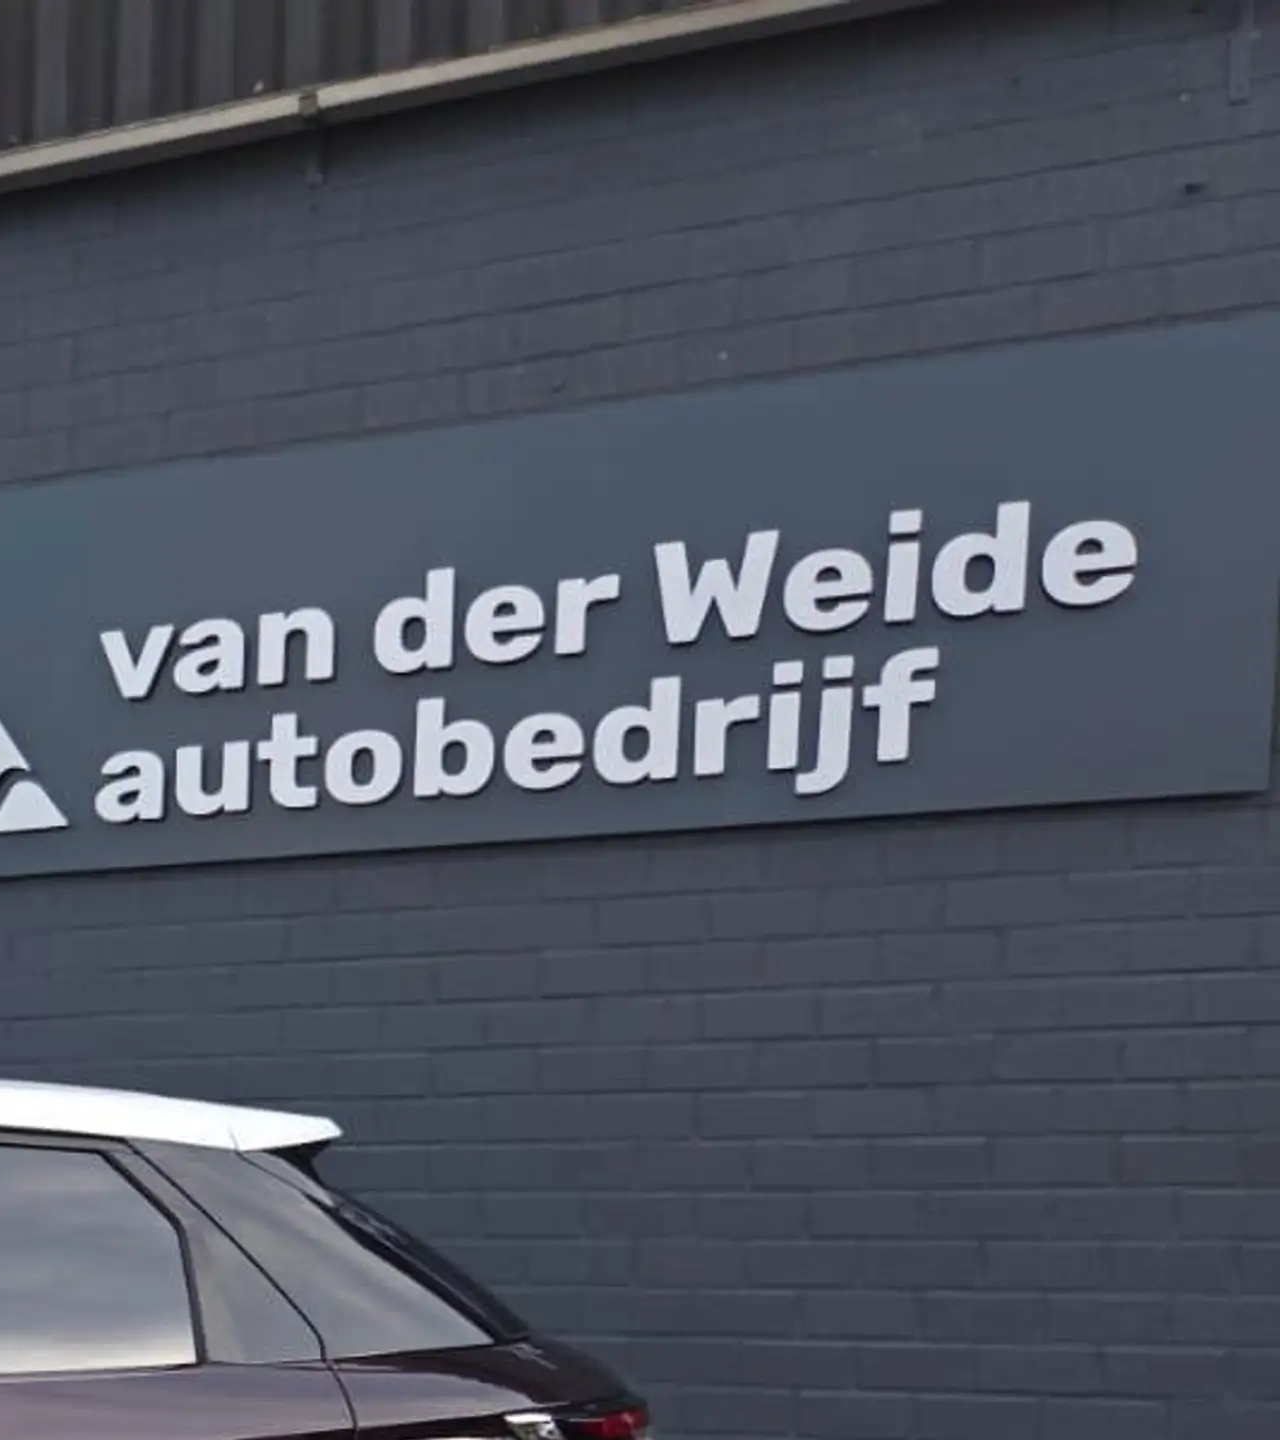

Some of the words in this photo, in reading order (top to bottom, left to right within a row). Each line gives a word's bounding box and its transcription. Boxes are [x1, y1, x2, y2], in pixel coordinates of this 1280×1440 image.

[98, 606, 335, 699] van
[372, 565, 622, 674] der
[652, 500, 1138, 645] Weide
[92, 646, 941, 823] autobedrijf
